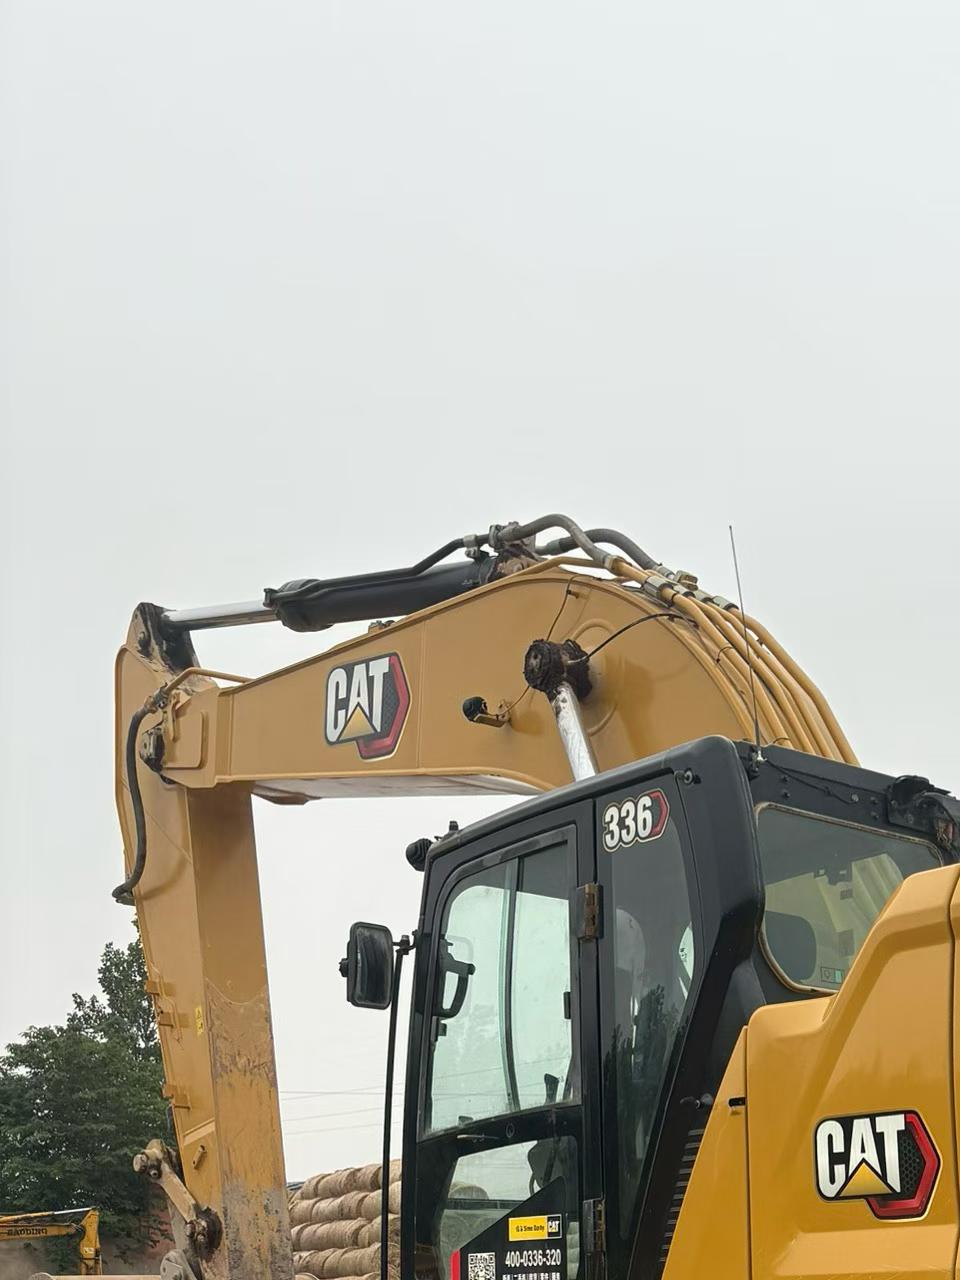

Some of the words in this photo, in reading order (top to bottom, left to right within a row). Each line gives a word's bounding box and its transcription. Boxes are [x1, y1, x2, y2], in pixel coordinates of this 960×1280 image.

[326, 656, 390, 742] CAT
[604, 795, 653, 848] 336
[816, 1113, 905, 1198] CAT
[548, 1221, 559, 1232] CAT
[505, 1249, 561, 1267] 400-0336-320
